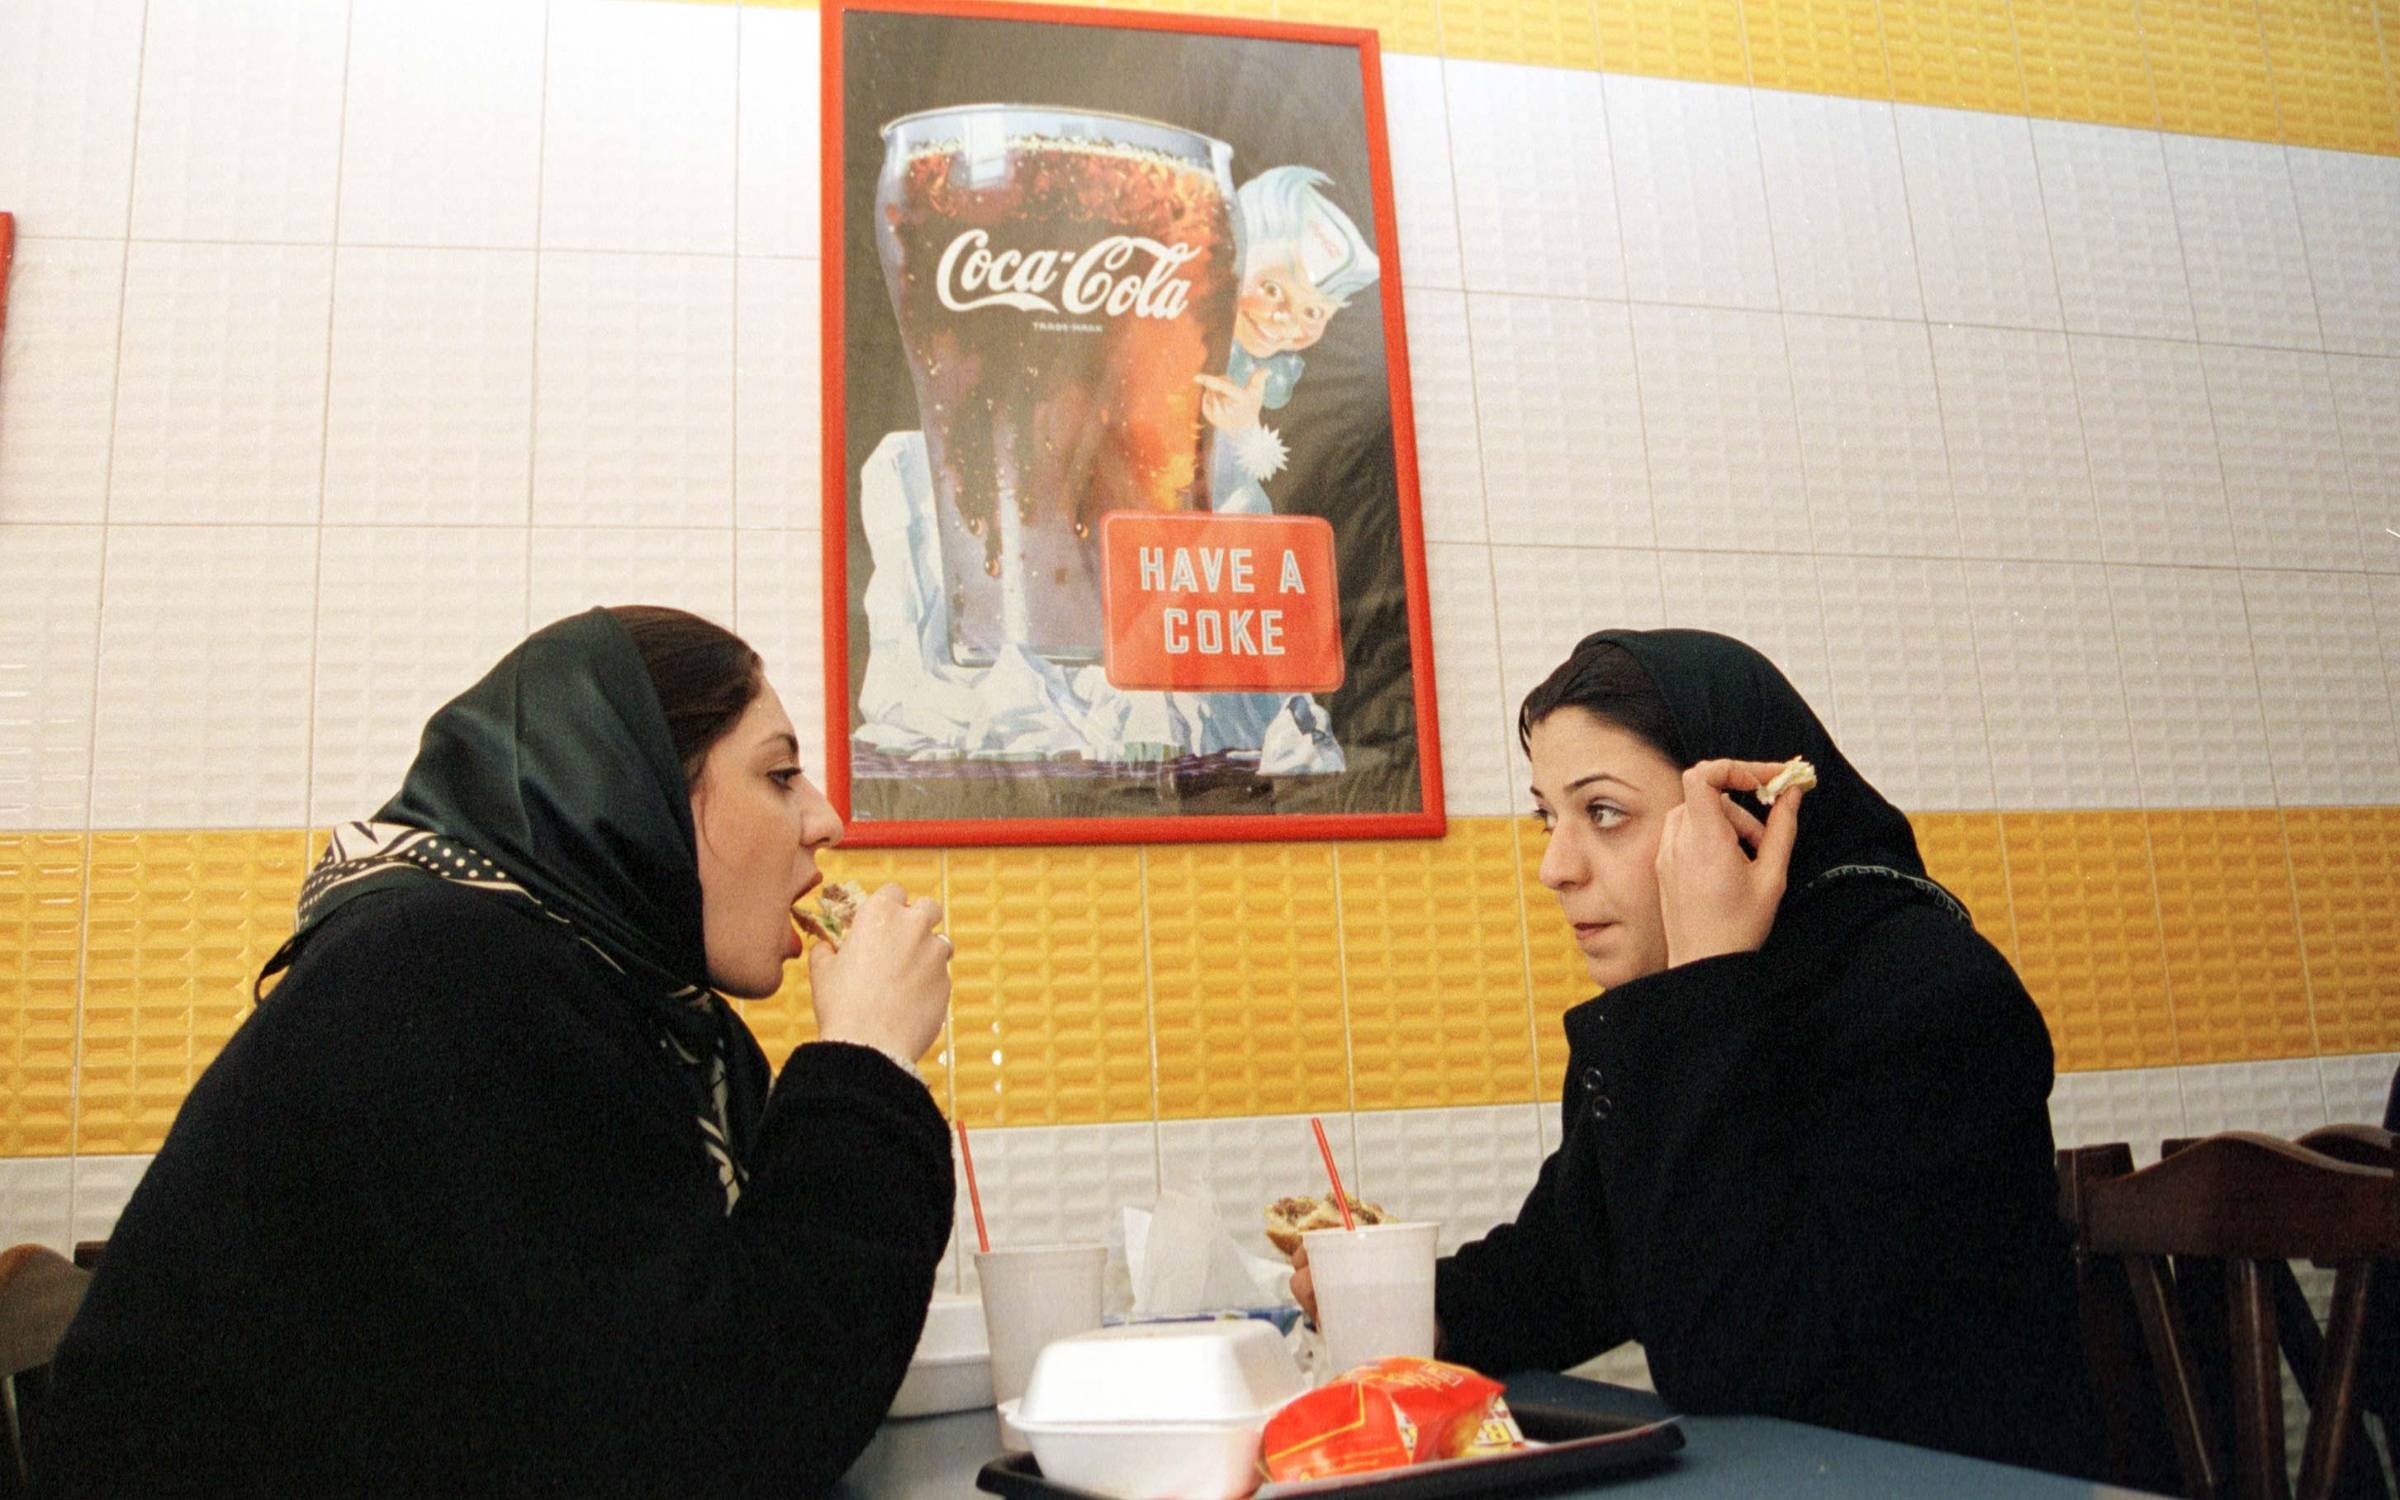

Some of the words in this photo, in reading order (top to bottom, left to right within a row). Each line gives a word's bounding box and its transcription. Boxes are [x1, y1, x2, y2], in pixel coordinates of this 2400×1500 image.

[936, 228, 1202, 320] Coca-Cola
[1139, 546, 1255, 593] HAVE
[1279, 549, 1306, 594] A
[1163, 607, 1286, 656] COKE
